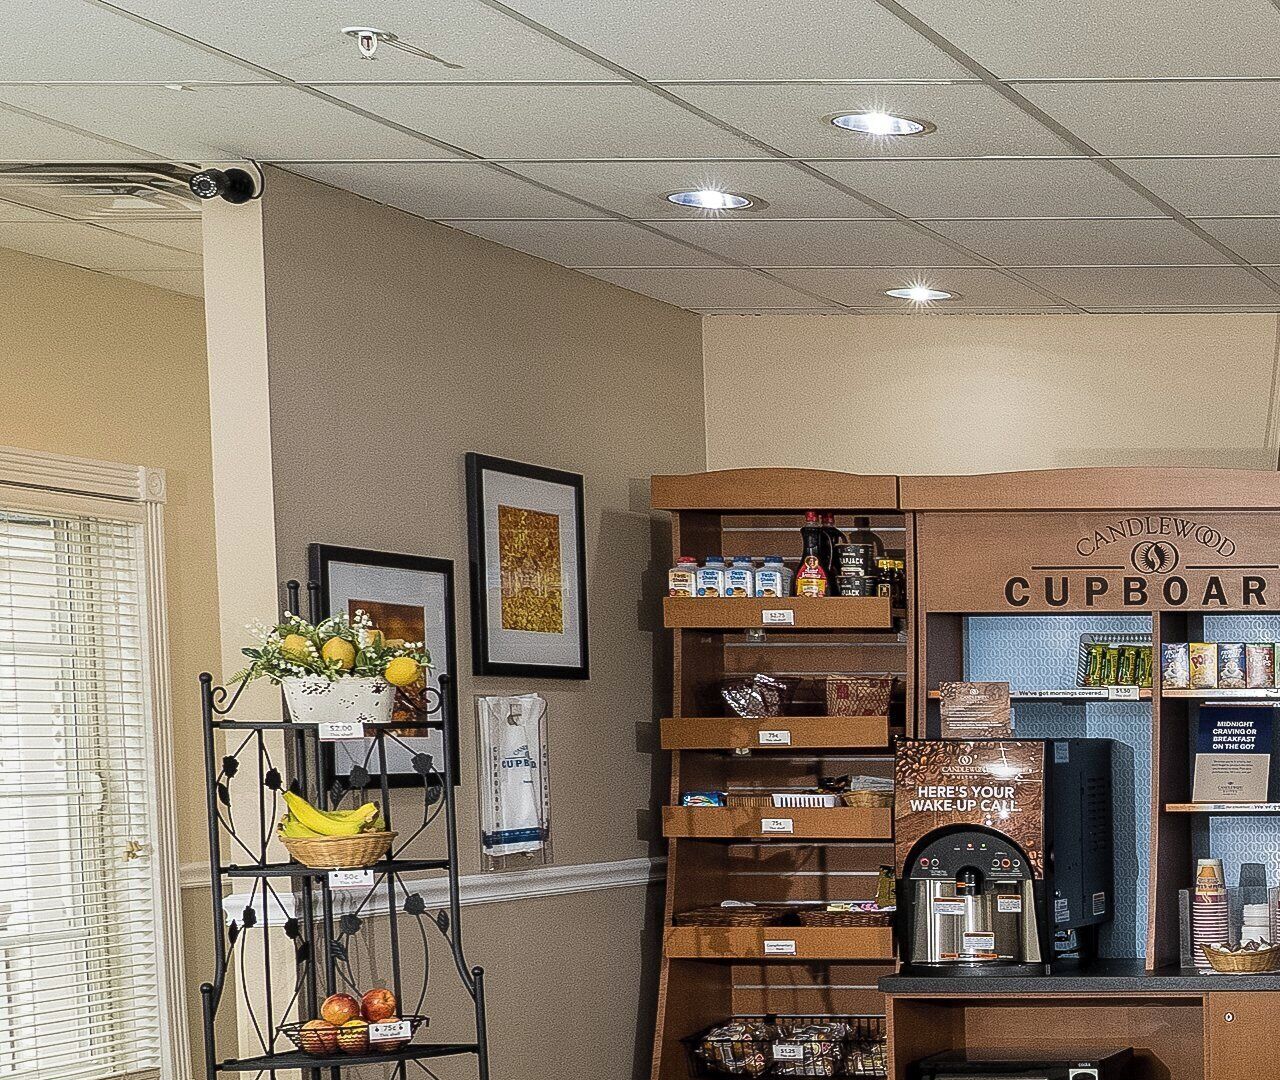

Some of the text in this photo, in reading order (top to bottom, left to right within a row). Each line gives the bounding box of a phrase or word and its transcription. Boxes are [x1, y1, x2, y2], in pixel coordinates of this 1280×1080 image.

[1076, 516, 1236, 557] CANDLEWOOD
[918, 786, 1015, 798] HERE'S YOUR
[909, 800, 1023, 812] WAKE-UP CALL.
